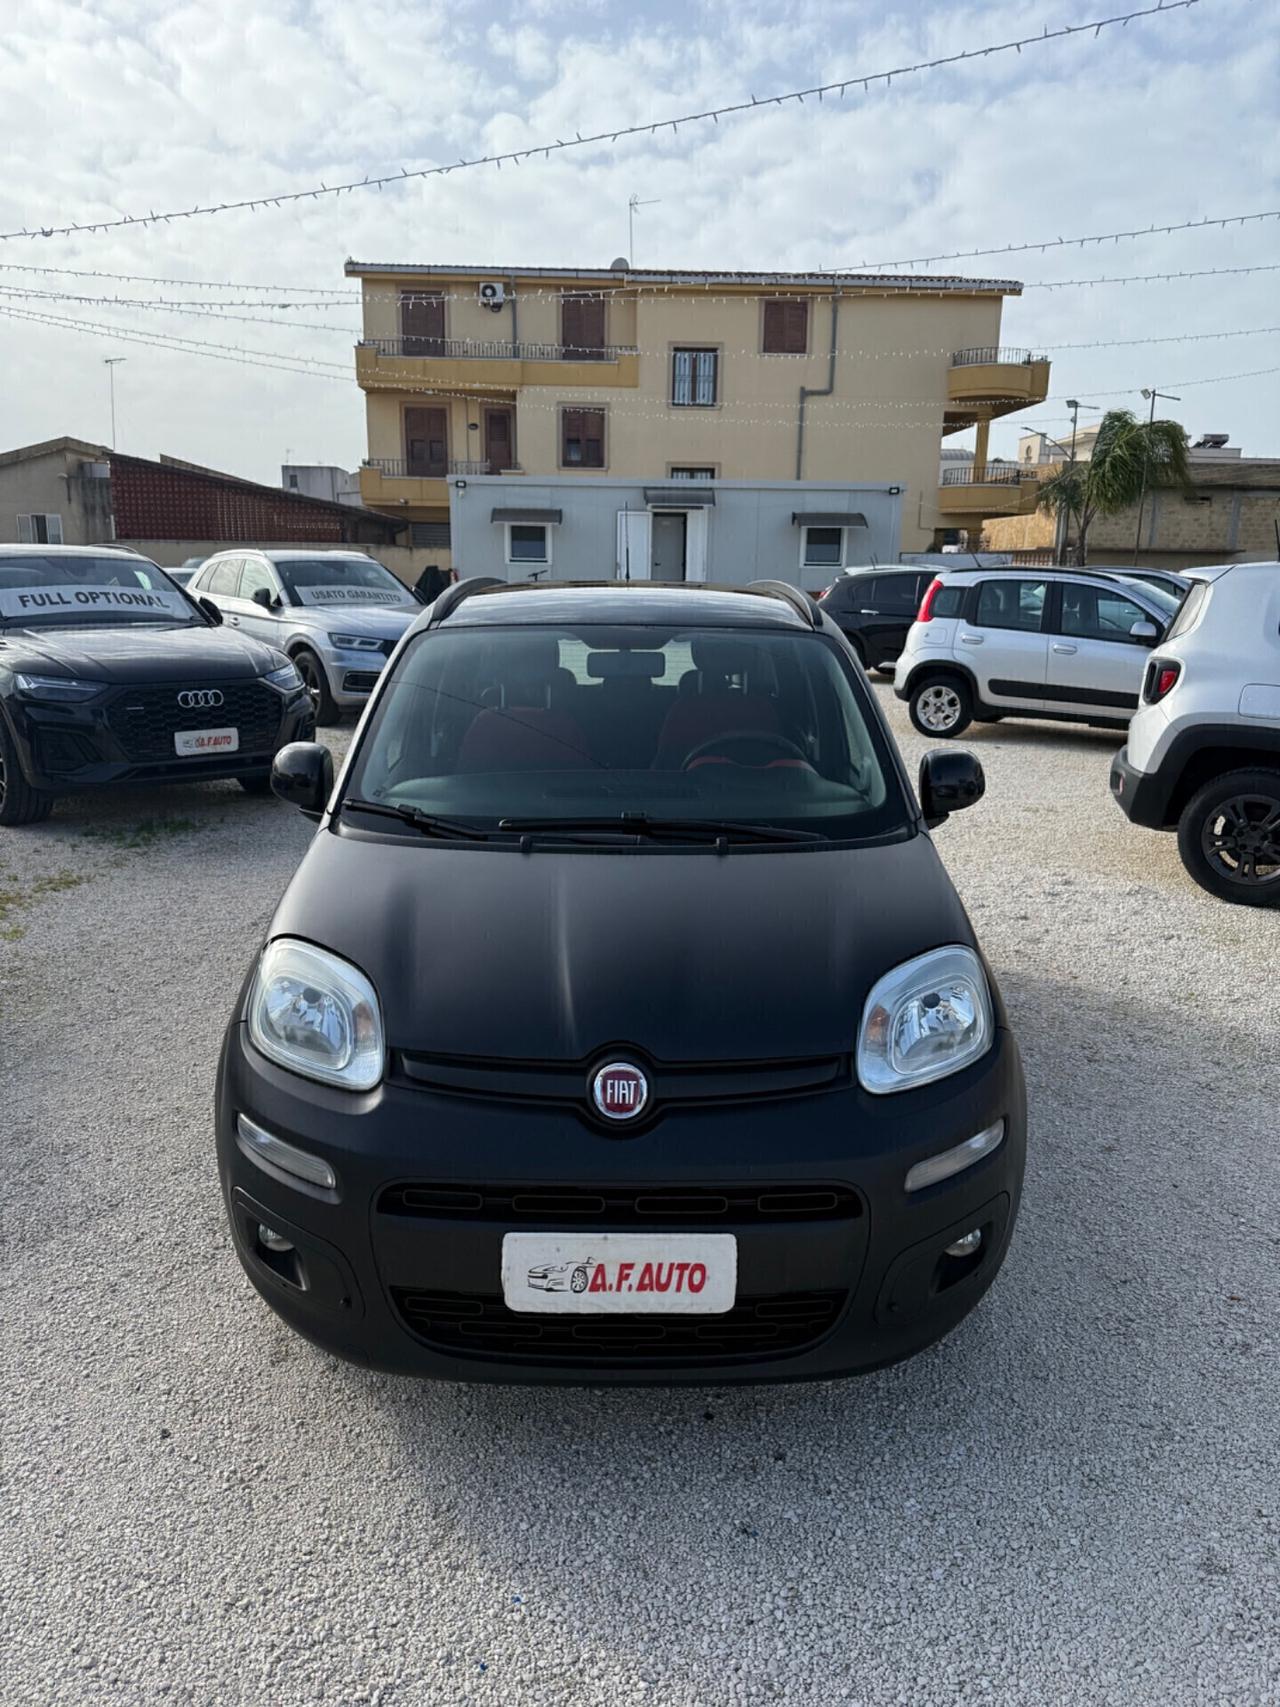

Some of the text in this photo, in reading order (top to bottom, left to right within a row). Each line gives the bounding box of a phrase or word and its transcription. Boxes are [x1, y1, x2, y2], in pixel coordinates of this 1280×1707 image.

[18, 591, 170, 609] FULL OPTIONAL
[311, 590, 400, 602] USATO GARANTITO
[606, 1079, 638, 1105] FIAT
